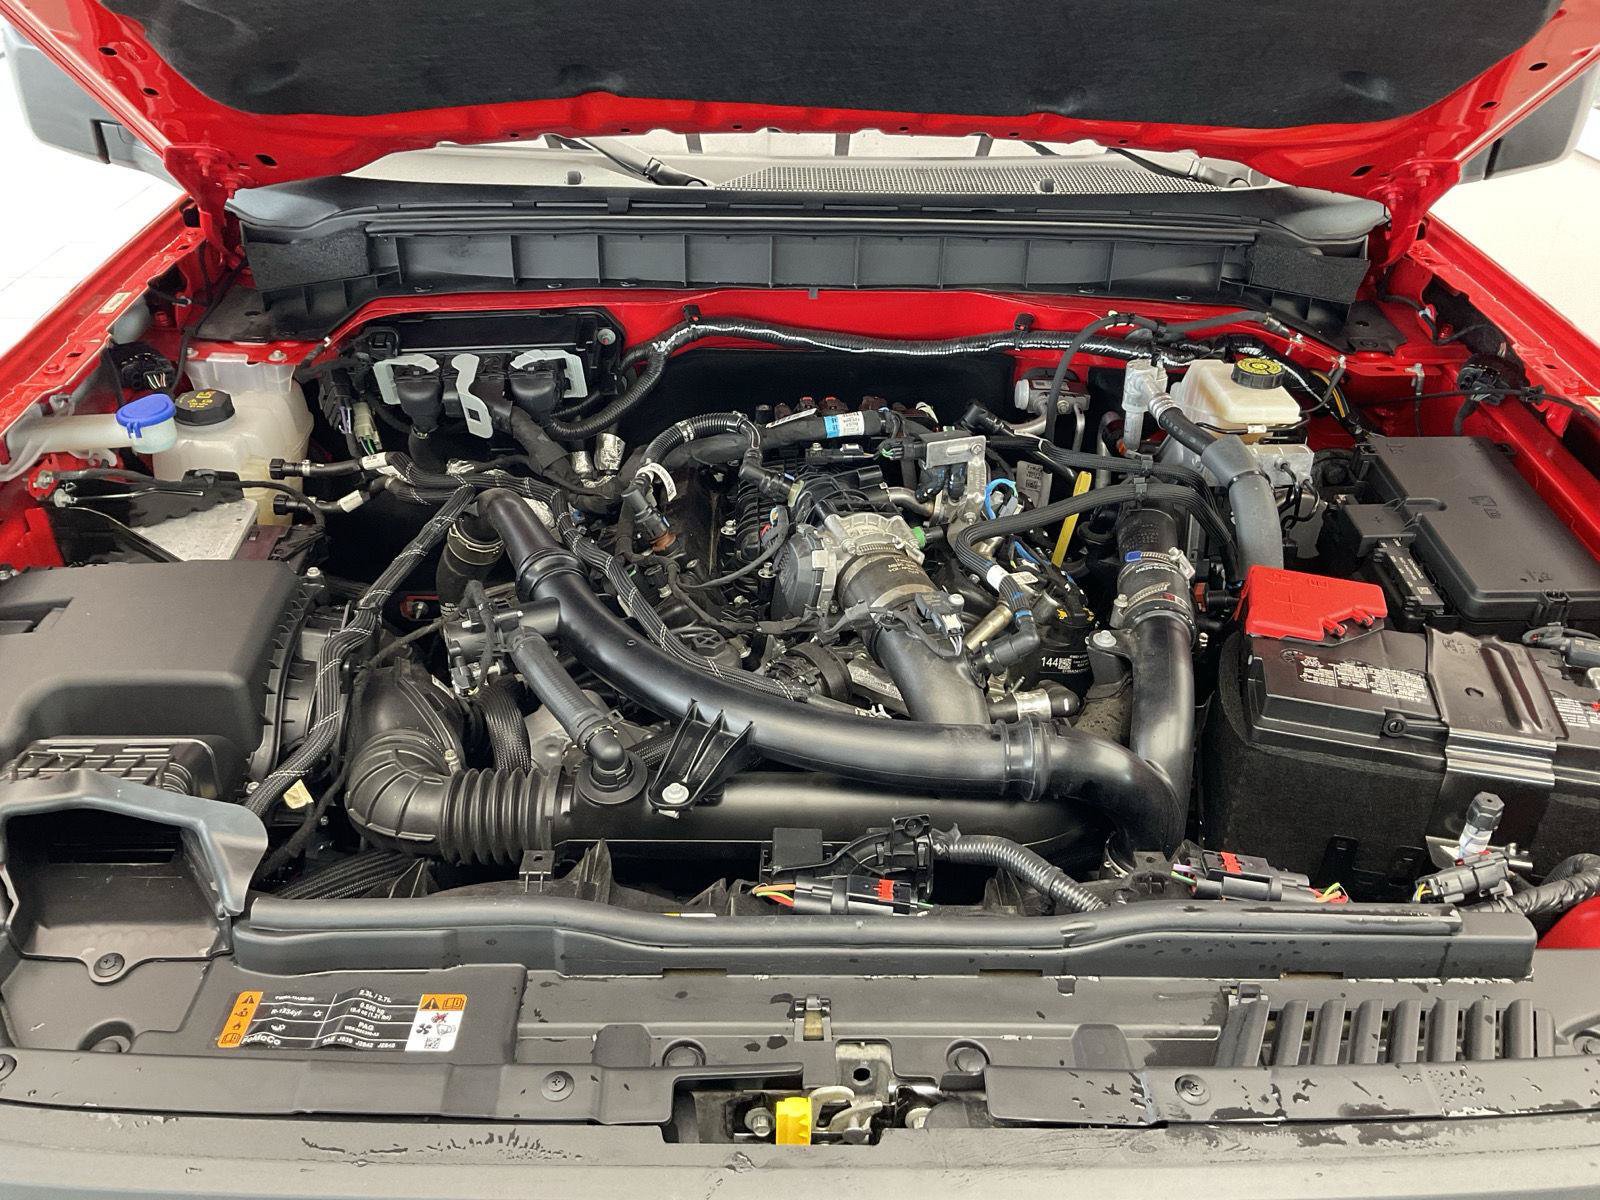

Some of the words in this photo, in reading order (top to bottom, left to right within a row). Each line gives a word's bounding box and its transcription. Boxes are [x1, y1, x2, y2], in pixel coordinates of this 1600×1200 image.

[1041, 656, 1059, 668] 144
[377, 995, 392, 1003] 2.7L
[358, 1021, 375, 1031] PAG
